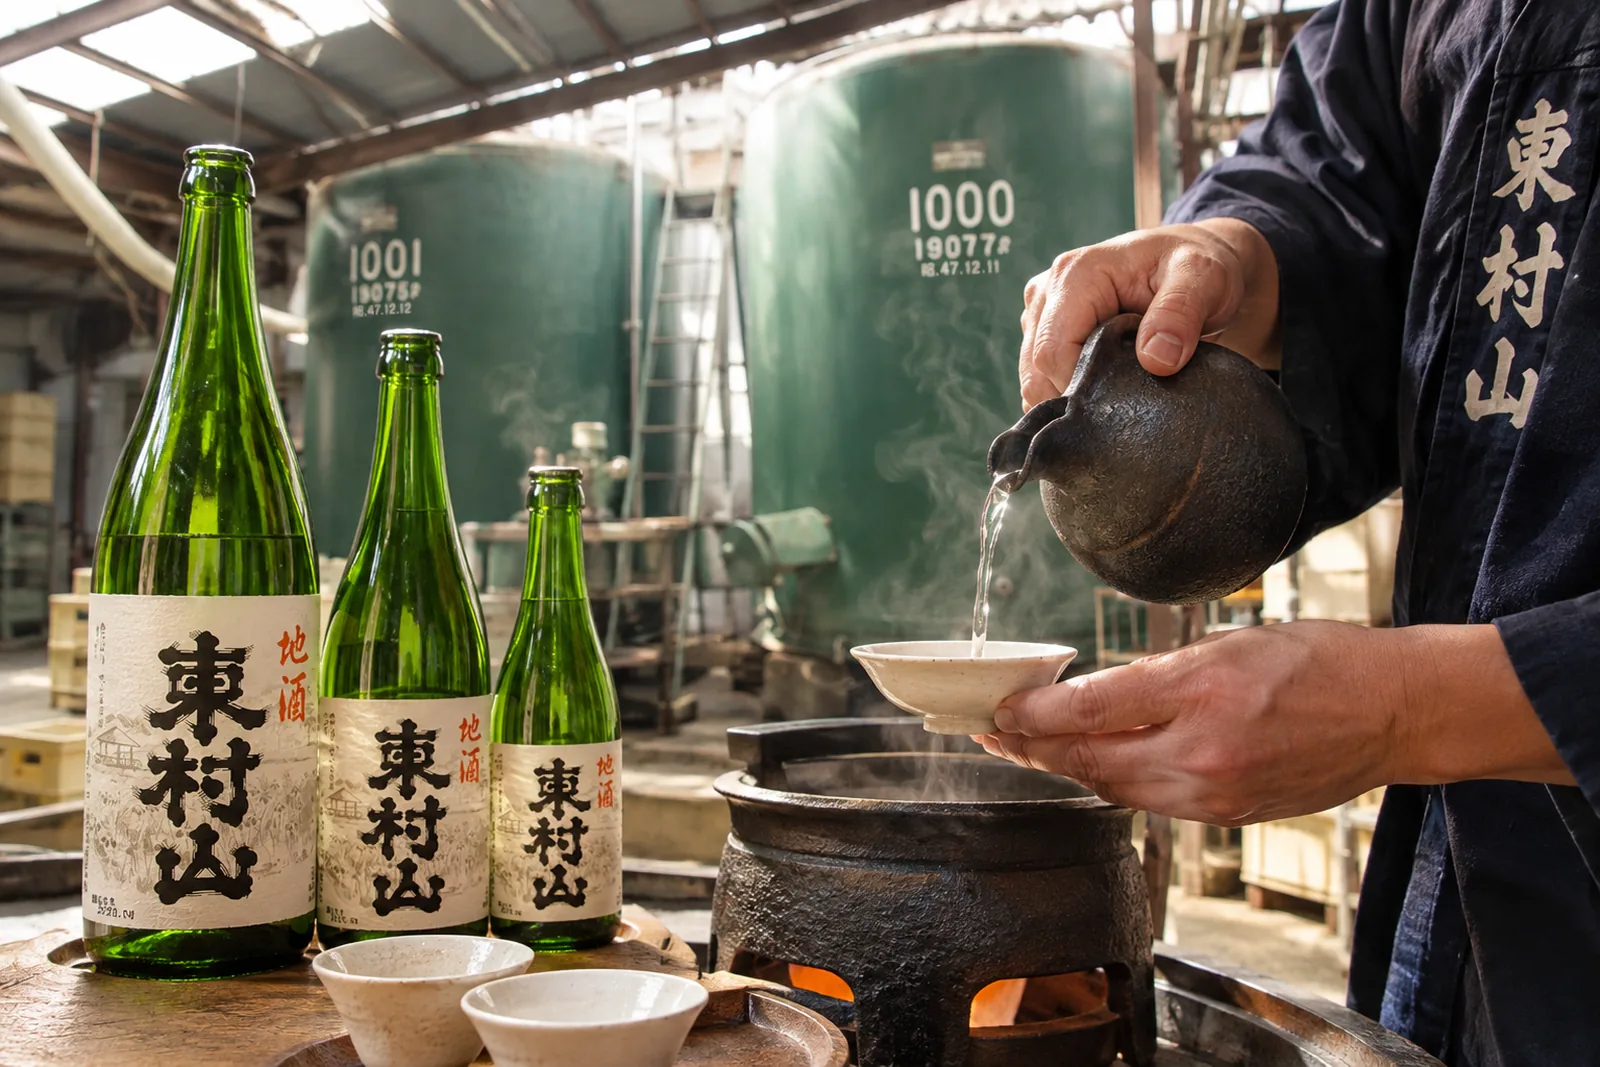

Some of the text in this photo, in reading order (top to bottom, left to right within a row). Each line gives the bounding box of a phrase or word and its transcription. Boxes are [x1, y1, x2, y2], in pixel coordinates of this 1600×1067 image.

[909, 179, 1015, 233] 1000
[349, 238, 422, 283] 1001
[1463, 98, 1576, 429] 東村山
[277, 624, 309, 723] 地酒
[132, 630, 270, 905] 東村山
[459, 713, 481, 784] 地酒
[596, 753, 615, 809] 地酒
[357, 718, 451, 917] 東村山
[524, 757, 591, 911] 東村山
